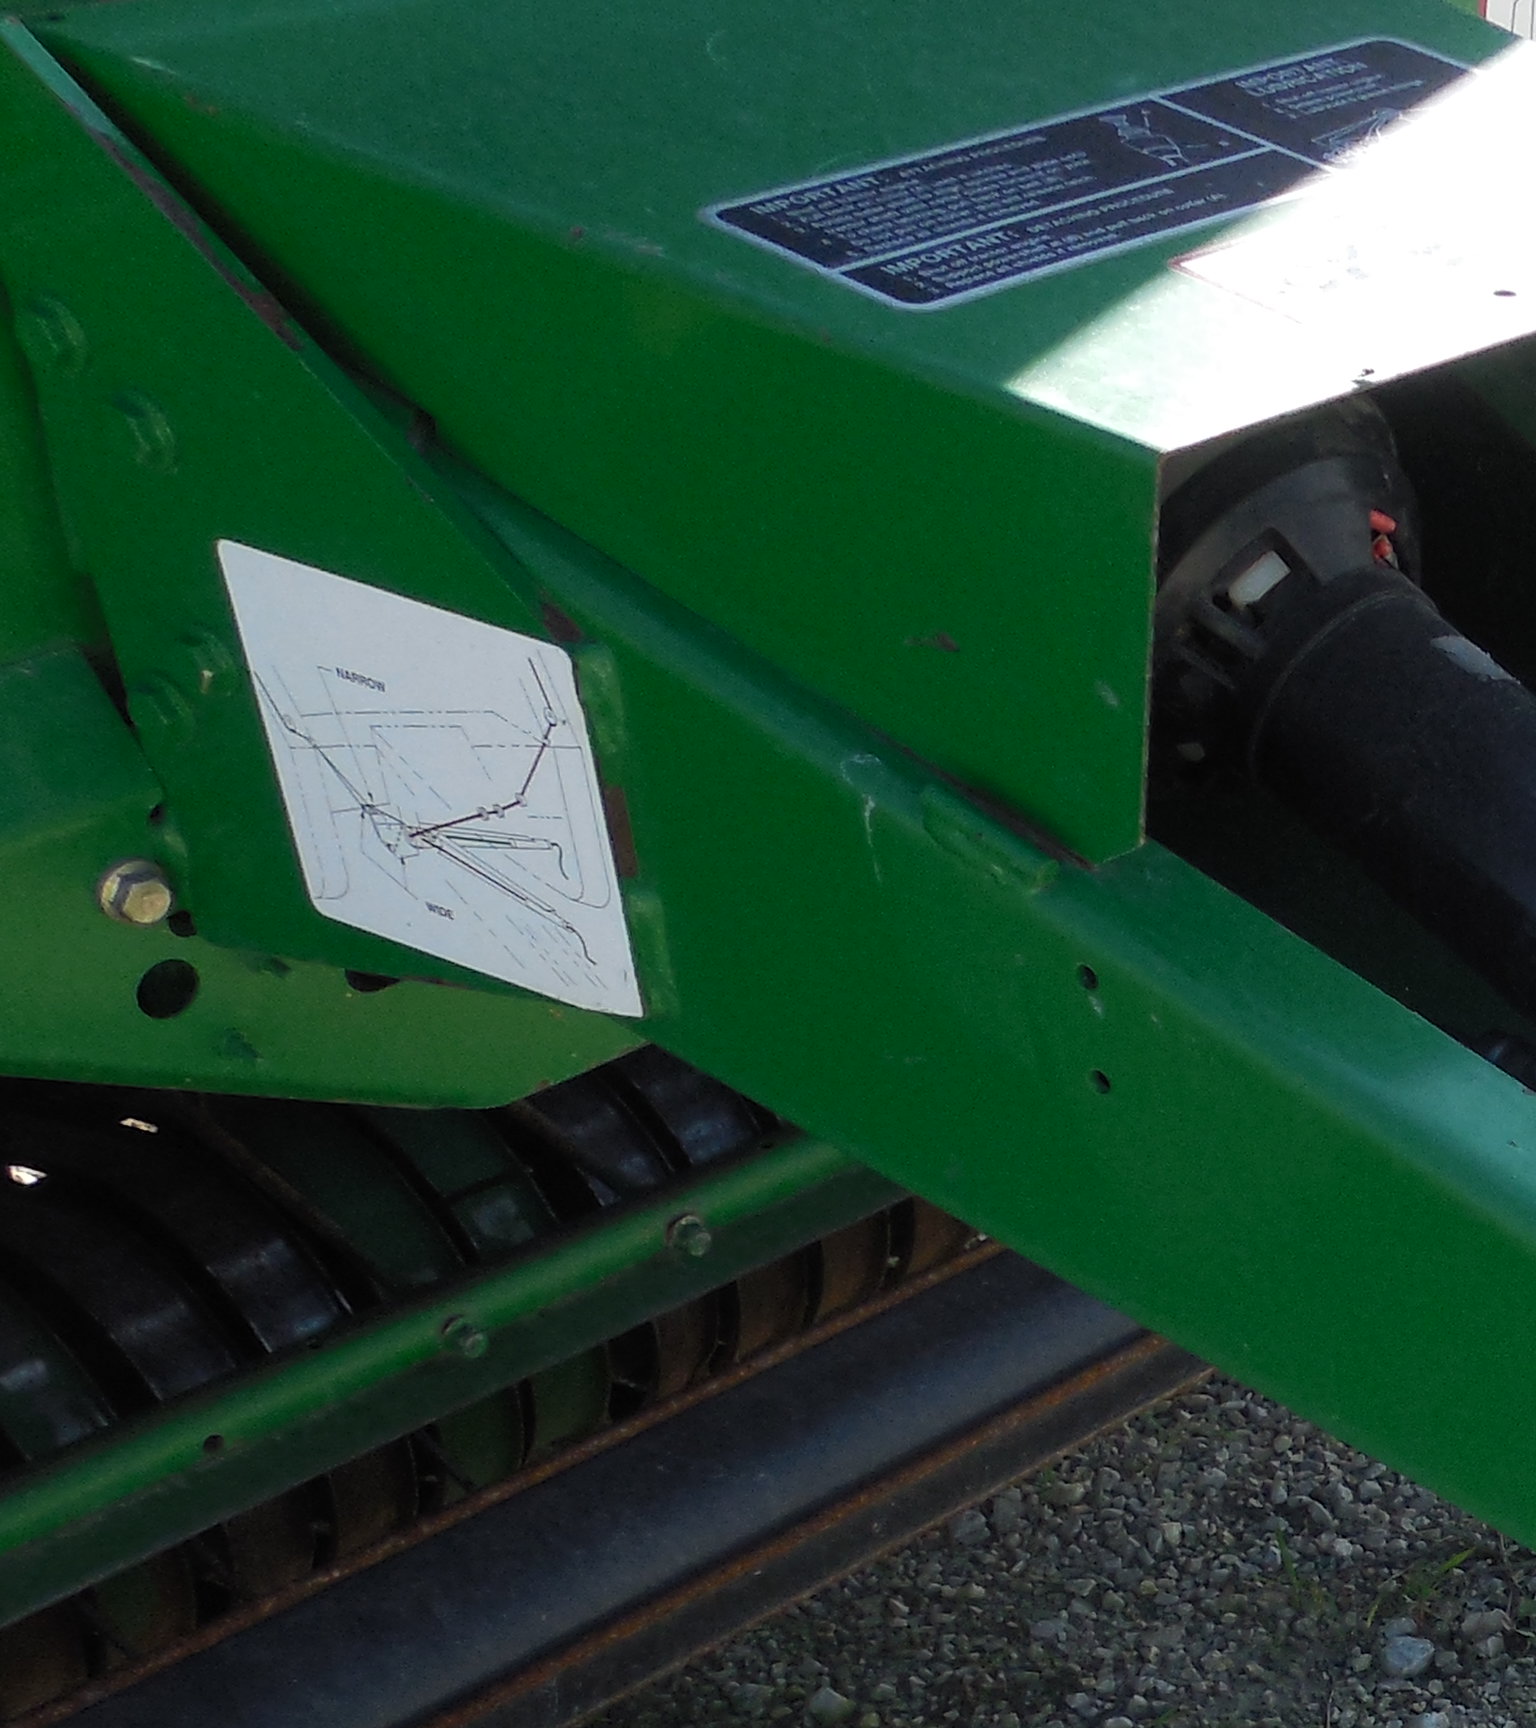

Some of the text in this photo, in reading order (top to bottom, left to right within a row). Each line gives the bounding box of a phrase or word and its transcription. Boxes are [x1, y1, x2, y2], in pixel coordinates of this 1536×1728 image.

[880, 231, 1019, 275] IMPORTANT:
[335, 667, 386, 693] NARROW
[424, 900, 455, 921] WIDE
